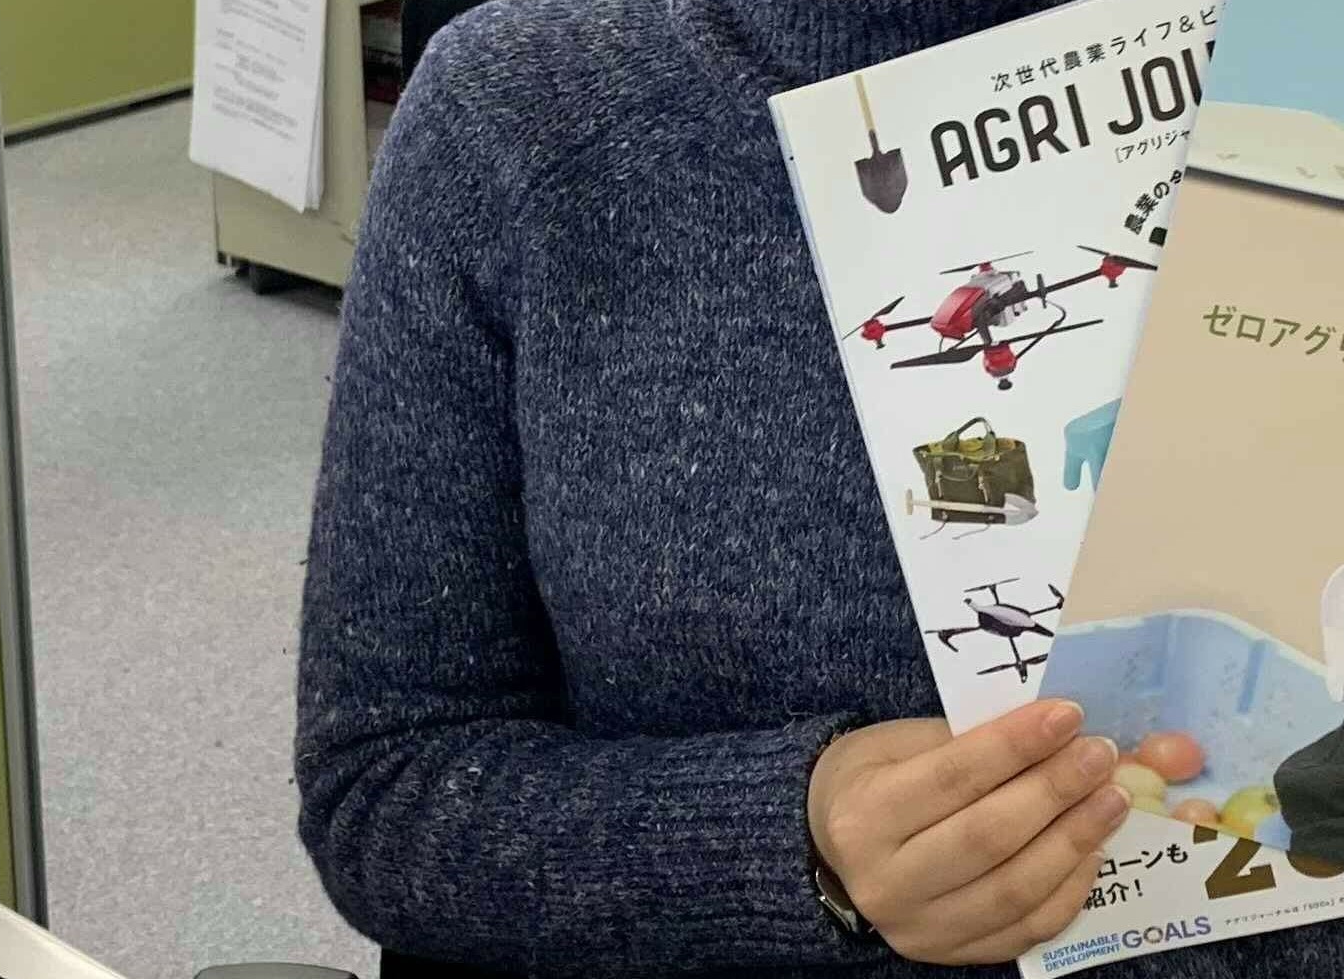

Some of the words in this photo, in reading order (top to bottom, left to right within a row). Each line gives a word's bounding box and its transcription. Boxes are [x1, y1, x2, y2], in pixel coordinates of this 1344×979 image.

[930, 83, 1092, 188] AGRI
[1041, 932, 1121, 963] SUSTAINABLE
[1121, 916, 1213, 950] GOALS
[1044, 943, 1122, 973] DEVELOPMENT
